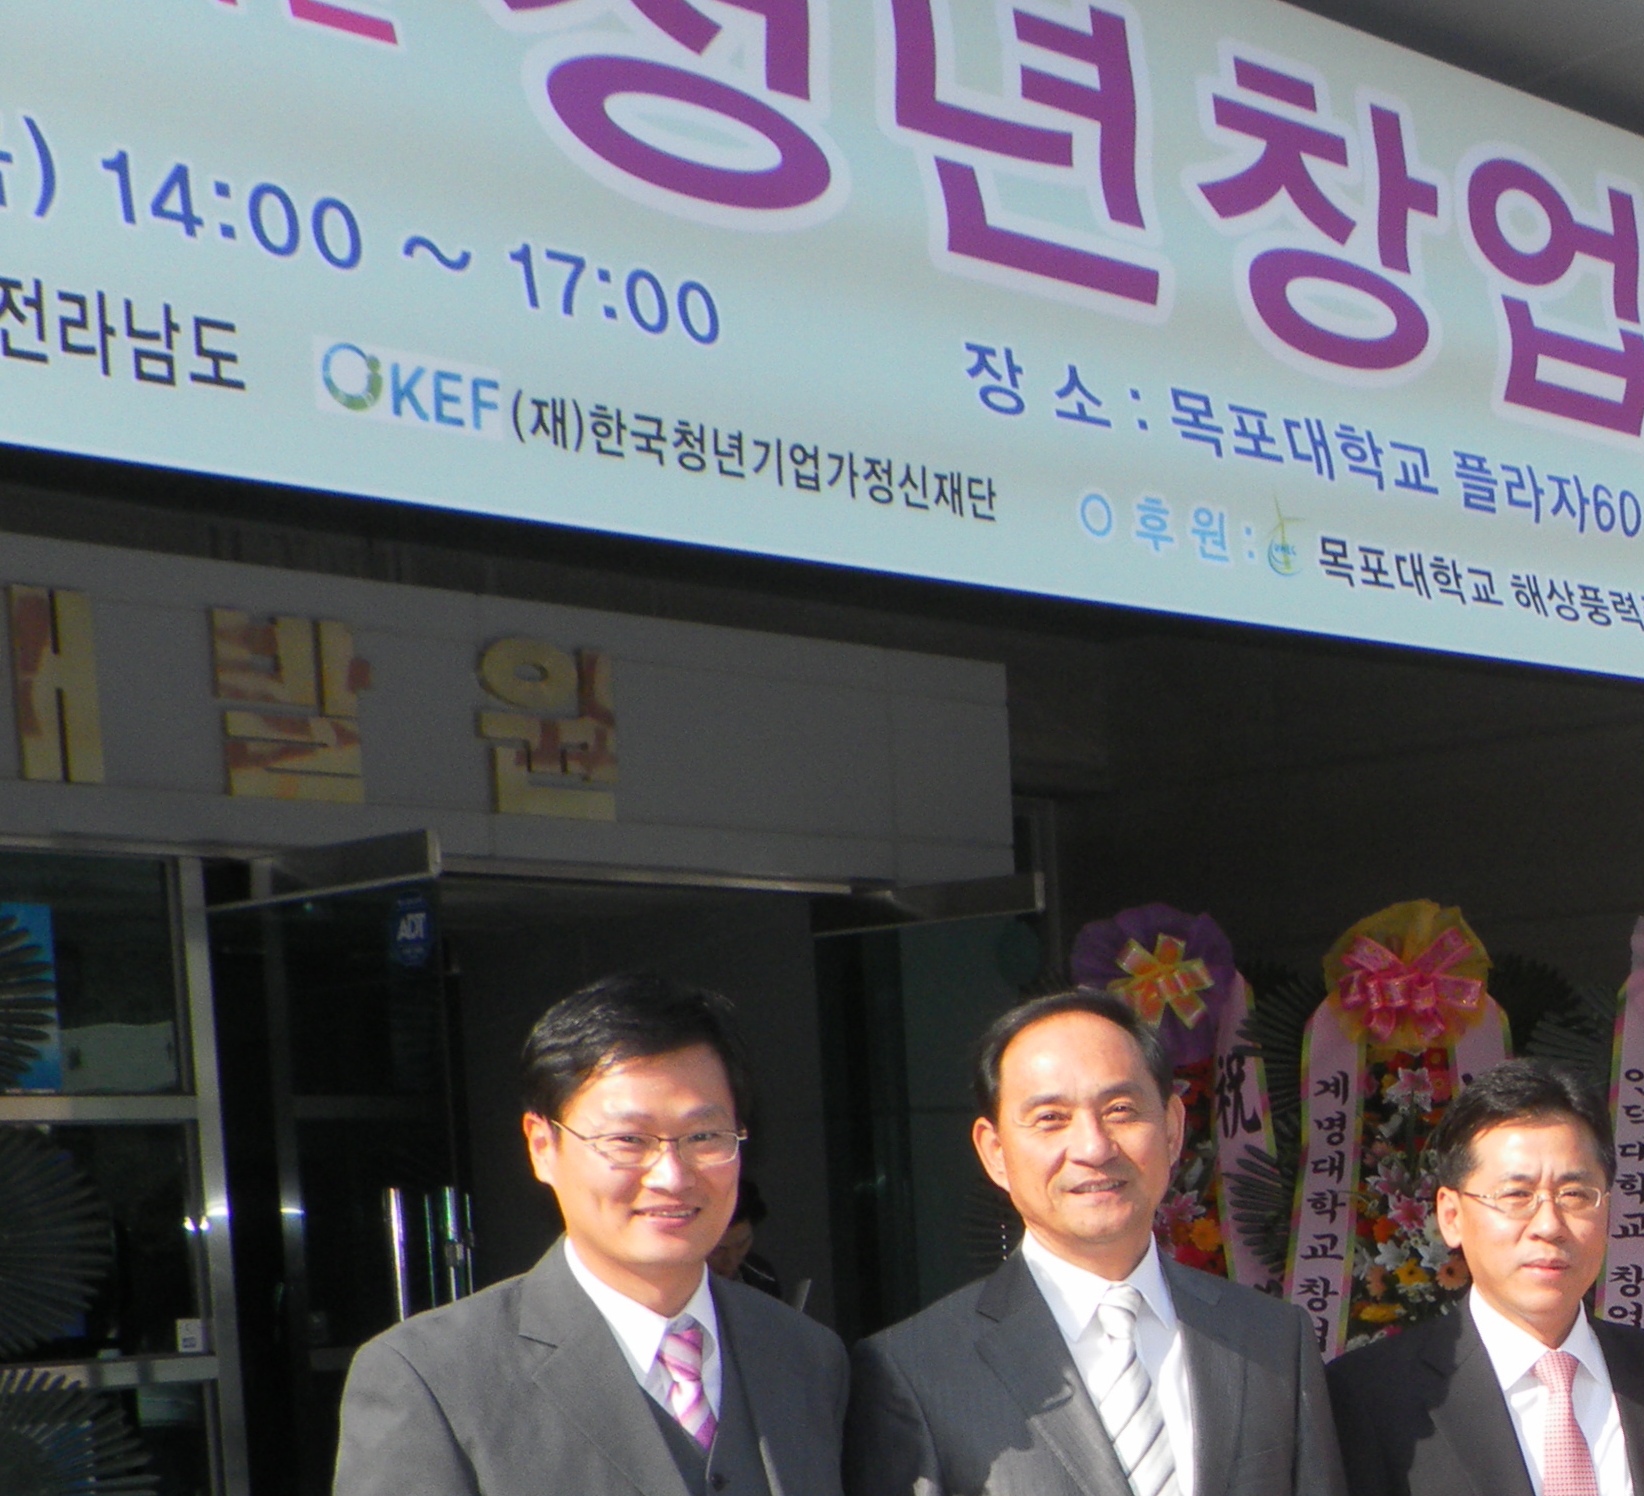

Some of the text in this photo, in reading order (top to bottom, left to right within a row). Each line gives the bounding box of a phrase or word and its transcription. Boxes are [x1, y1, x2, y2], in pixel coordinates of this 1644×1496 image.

[101, 149, 362, 271] 14:00
[510, 243, 719, 345] 17:00
[0, 277, 246, 391] 전라남도
[510, 388, 997, 522] (재)한국청년기업가정신재단
[1170, 385, 1440, 497] 목포대학교
[1453, 450, 1642, 538] 플라자60
[1319, 535, 1503, 606] 목포대학교
[1300, 1071, 1351, 1262] 계명대학교
